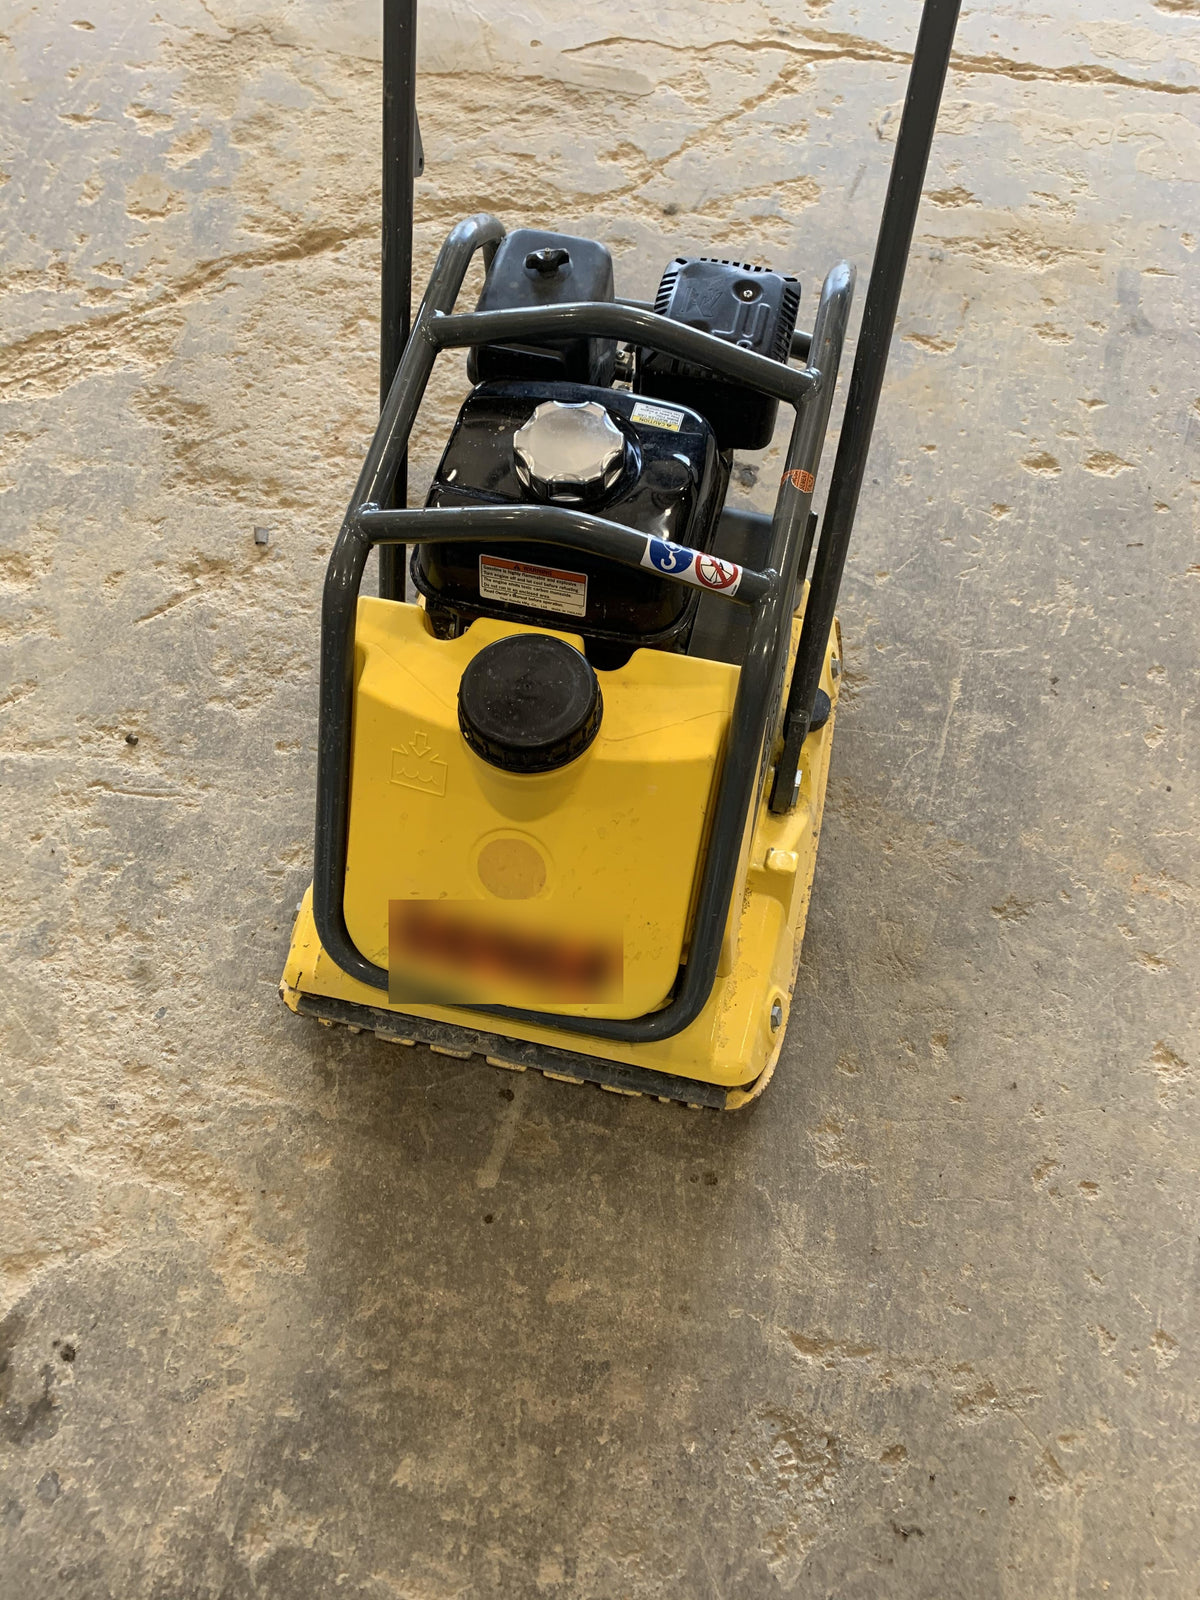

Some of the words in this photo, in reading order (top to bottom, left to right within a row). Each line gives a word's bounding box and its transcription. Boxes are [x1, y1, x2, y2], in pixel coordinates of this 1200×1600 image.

[639, 417, 665, 426] CAUTION
[524, 566, 551, 574] WARNING
[522, 573, 545, 581] flammable
